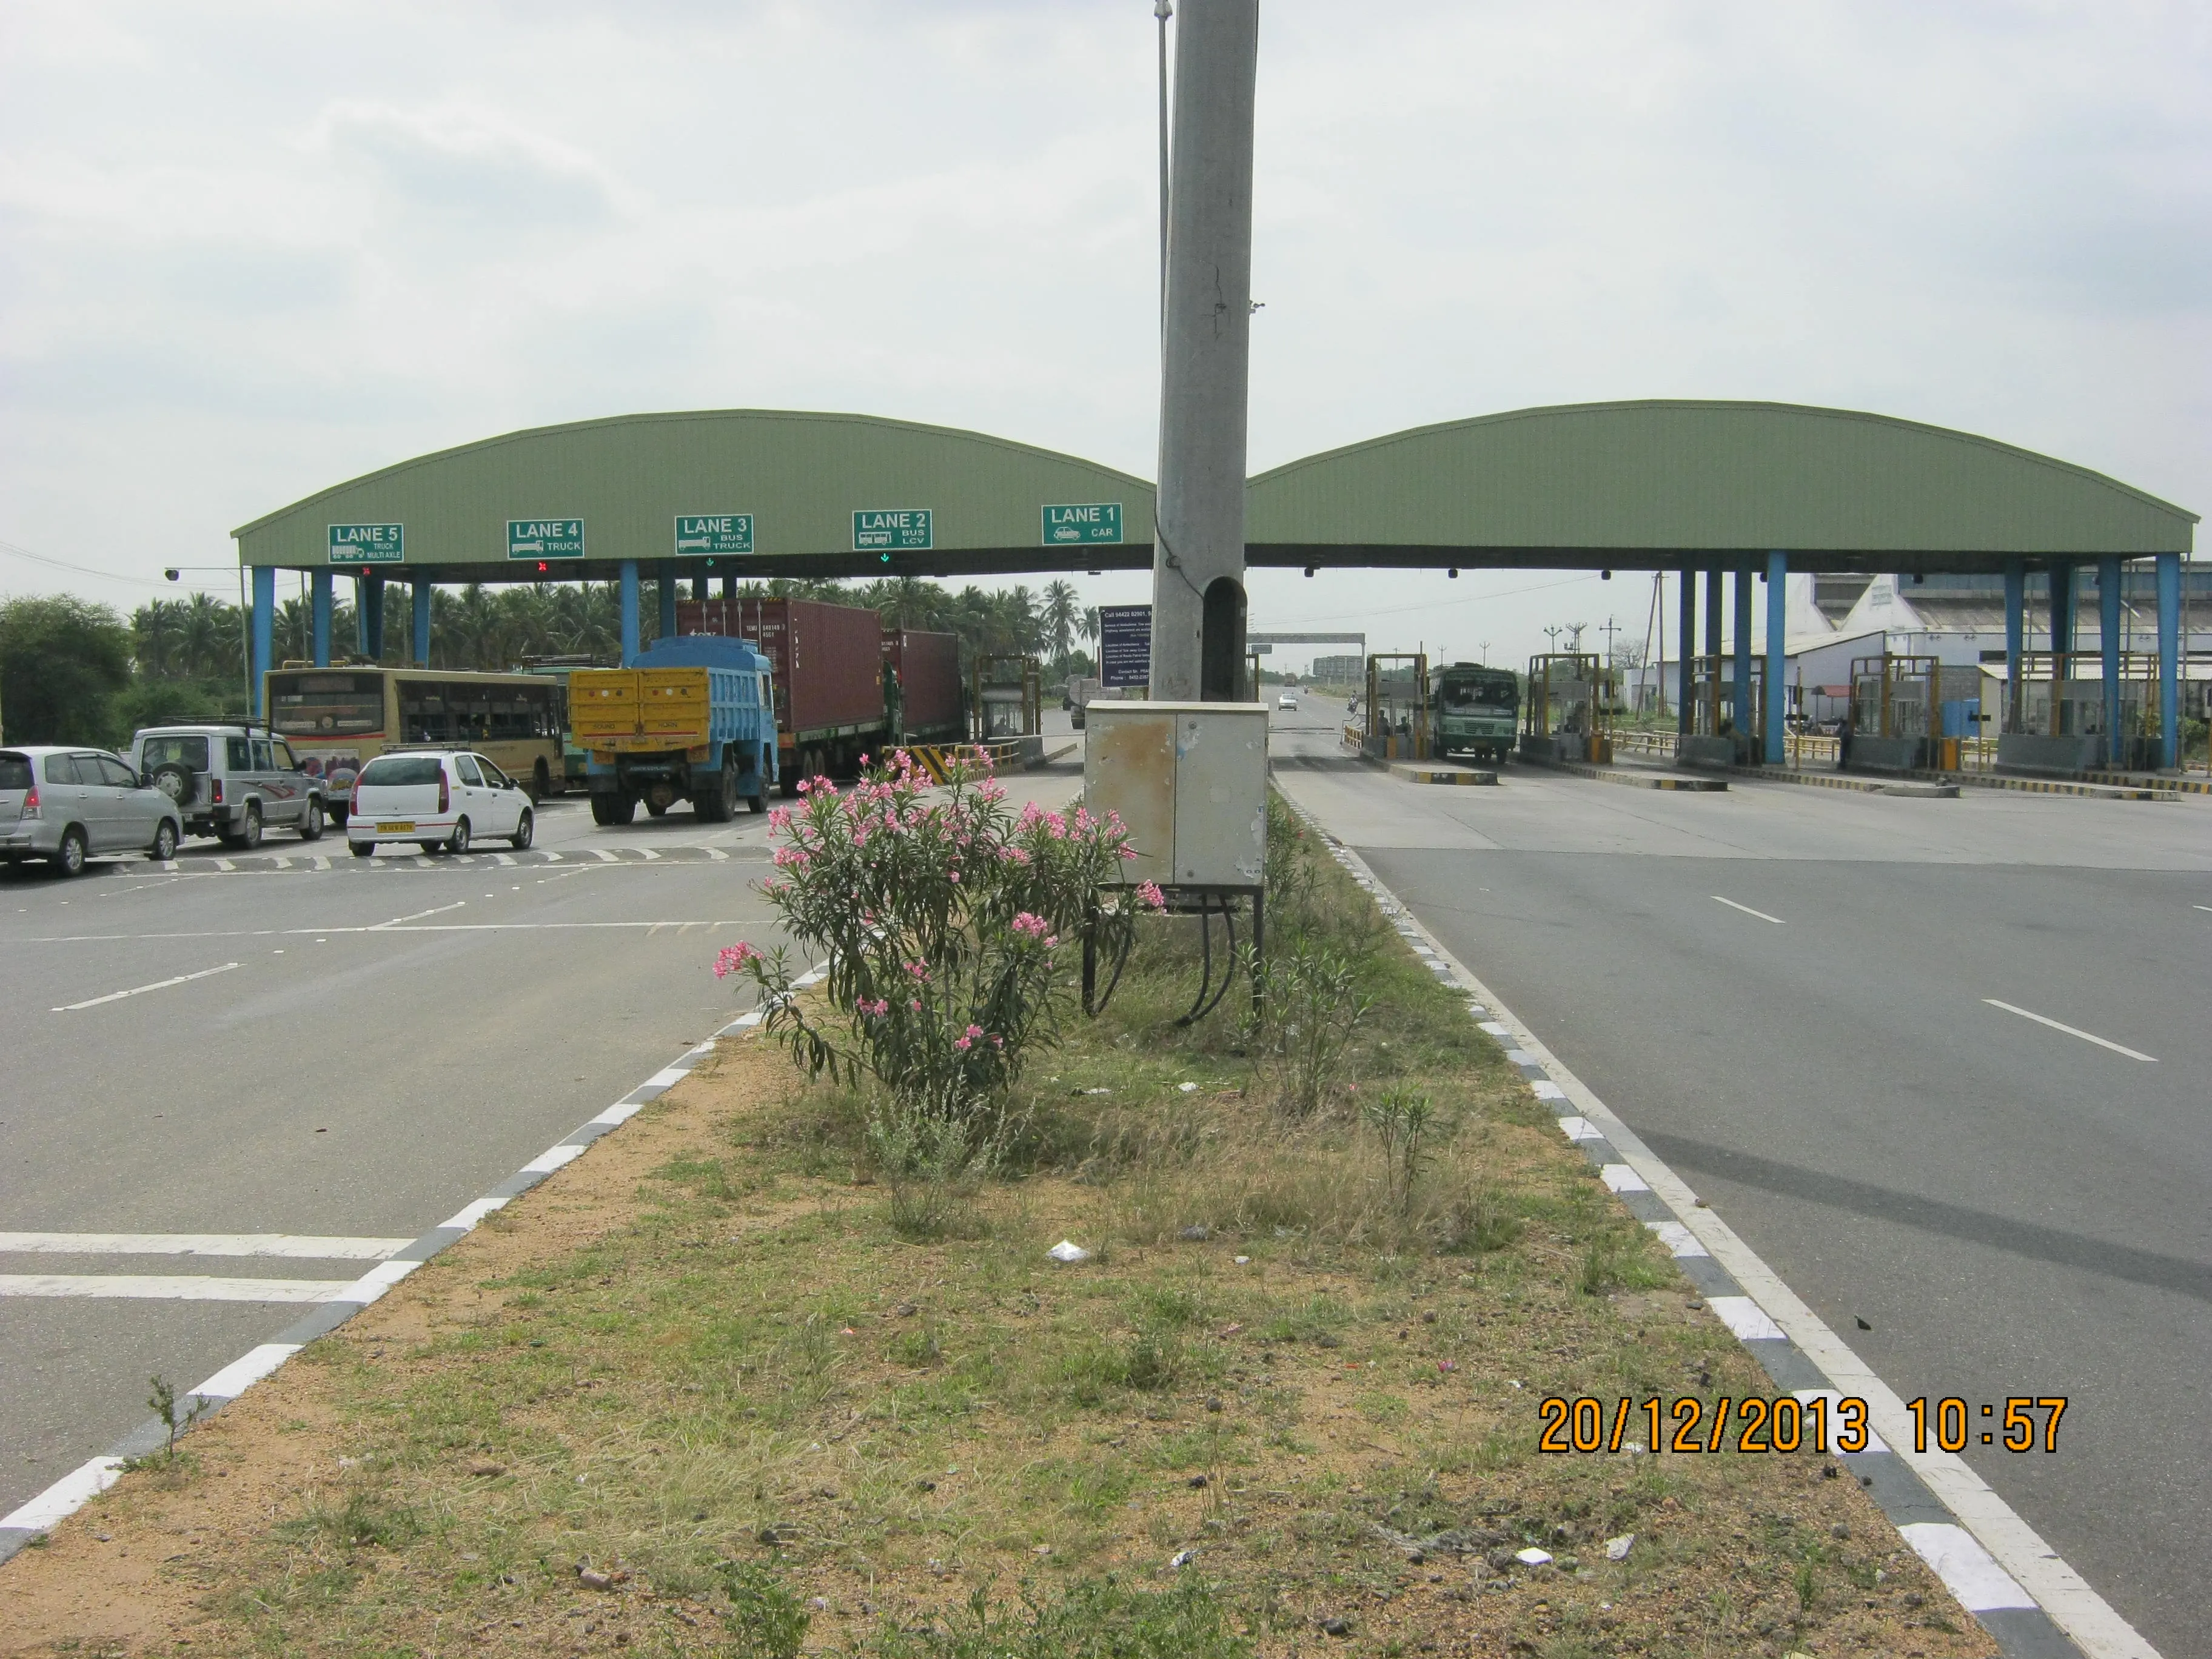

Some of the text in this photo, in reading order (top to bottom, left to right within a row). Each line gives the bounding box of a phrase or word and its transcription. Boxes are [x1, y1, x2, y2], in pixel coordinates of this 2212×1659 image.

[862, 513, 925, 529] LANE 2
[1051, 507, 1114, 523] LANE 1
[516, 522, 578, 538] LANE 4
[684, 518, 747, 534] LANE 3
[1091, 528, 1113, 537] CAR
[337, 527, 398, 542] LANE 5
[547, 541, 581, 551] TRUCK
